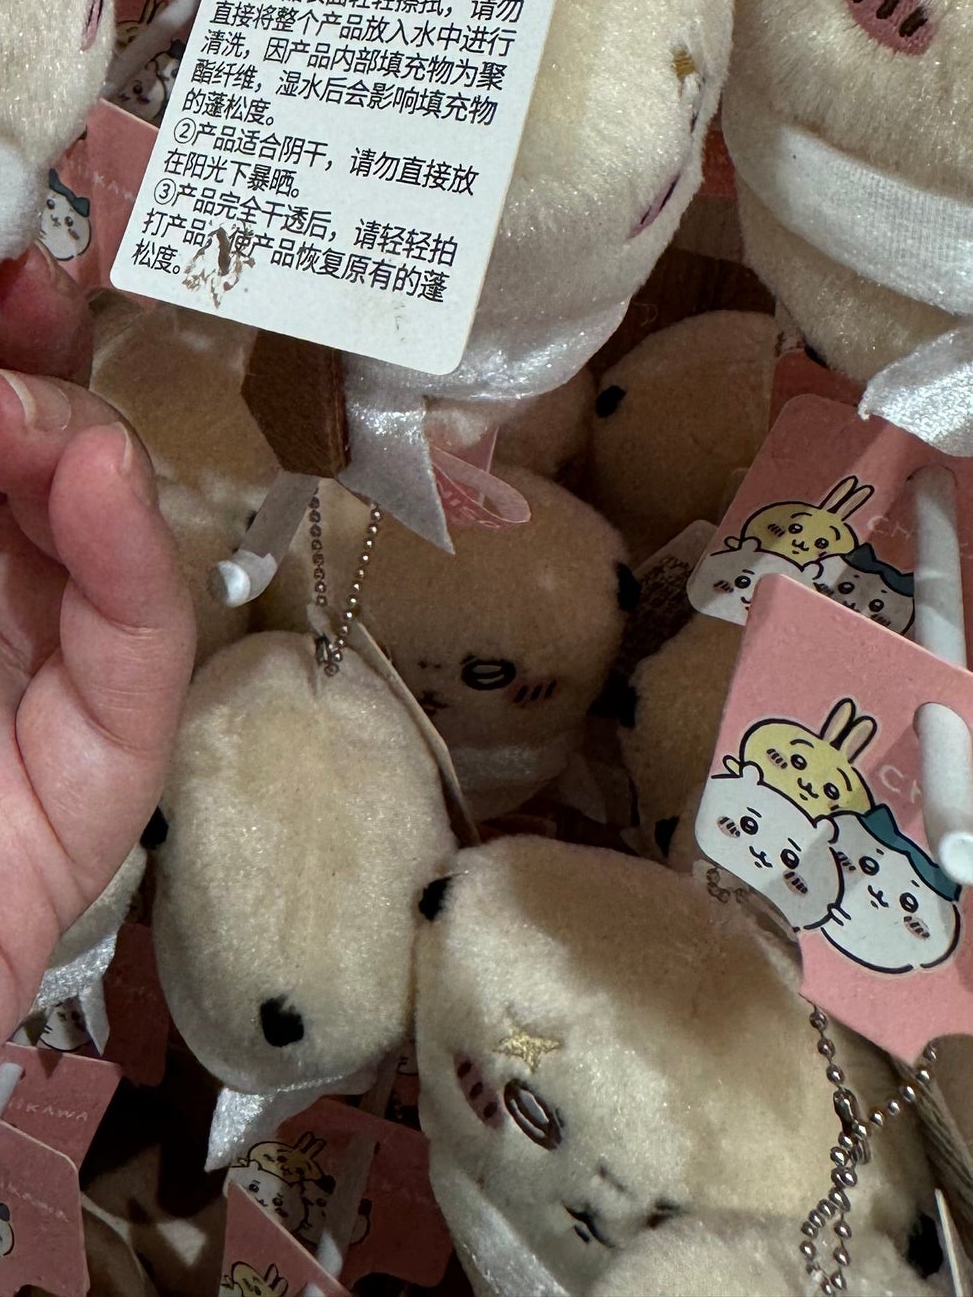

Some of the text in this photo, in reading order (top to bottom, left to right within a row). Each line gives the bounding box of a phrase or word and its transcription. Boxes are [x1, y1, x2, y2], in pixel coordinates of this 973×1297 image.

[209, 0, 517, 58] 直接将整个产品放入水中进行
[200, 29, 507, 92] 清洗，因产品内部填充物为聚
[181, 89, 276, 129] 的蓬松度。
[189, 58, 498, 127] 酯纤维，湿水后会影响填充物
[164, 148, 300, 199] 在阳光下暴晒。
[131, 238, 181, 276] 松度。
